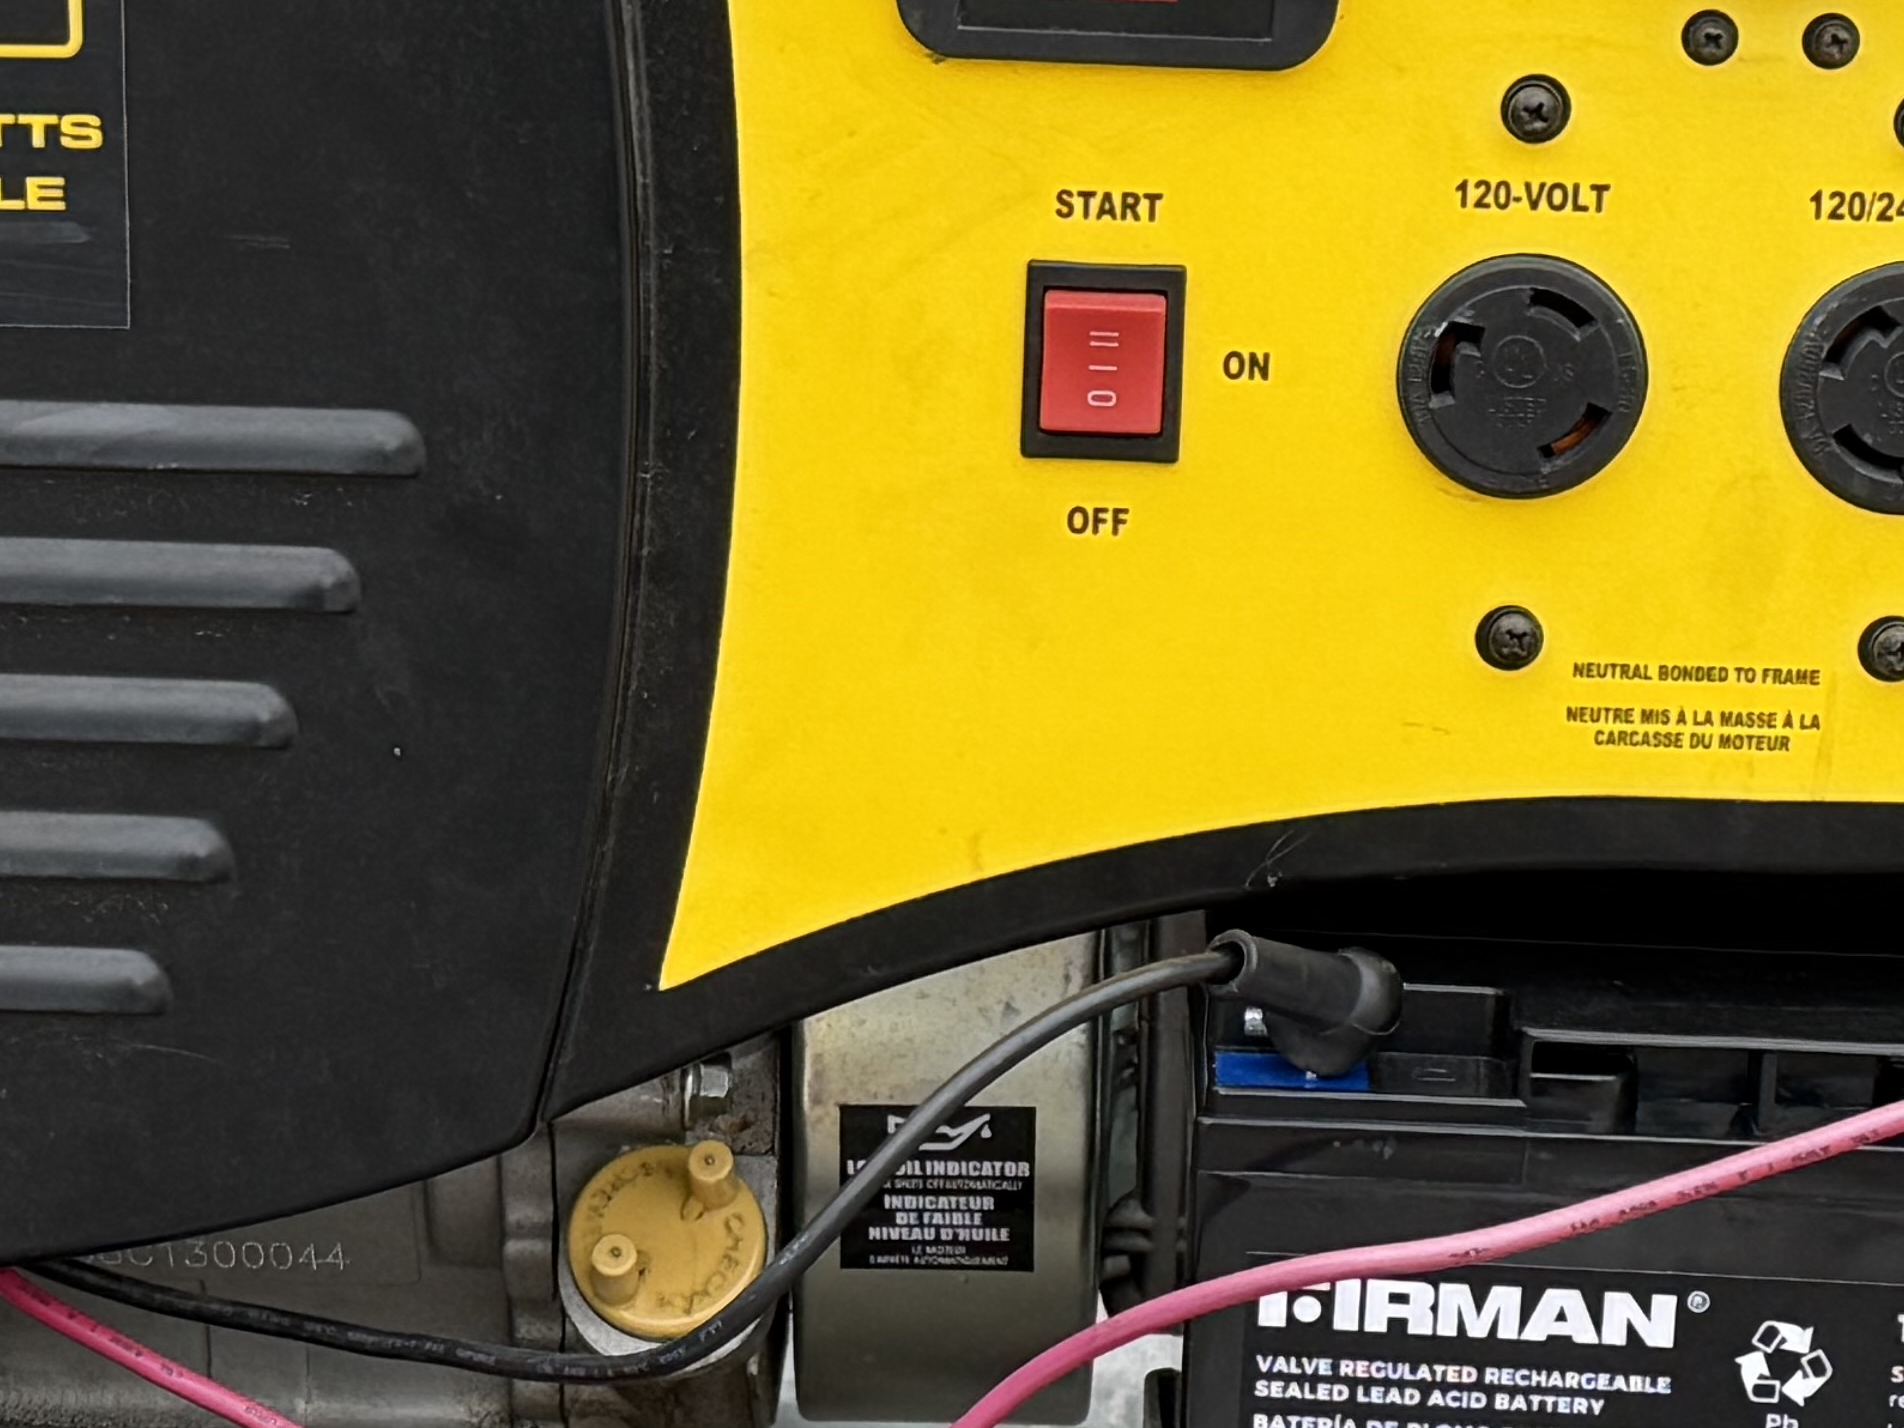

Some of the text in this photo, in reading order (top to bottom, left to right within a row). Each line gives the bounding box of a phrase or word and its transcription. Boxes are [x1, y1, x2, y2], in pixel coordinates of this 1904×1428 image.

[1055, 189, 1164, 222] START
[1455, 179, 1611, 213] 120-VOLT
[1223, 350, 1270, 381] ON
[1067, 506, 1130, 535] OFF
[1572, 662, 1820, 686] NEUTRAL BONDED TO FRAME
[1566, 705, 1820, 730] NEUTRE MIS À LA MASSE À LA
[1593, 729, 1790, 752] CARCASSE DU MOTEUR
[884, 1194, 994, 1210] INDICATEUR
[1256, 1354, 1671, 1394] VALVE REGULATED RECHARGEABLE
[1254, 1379, 1604, 1415] SEALED LEAD ACID BATTERY
